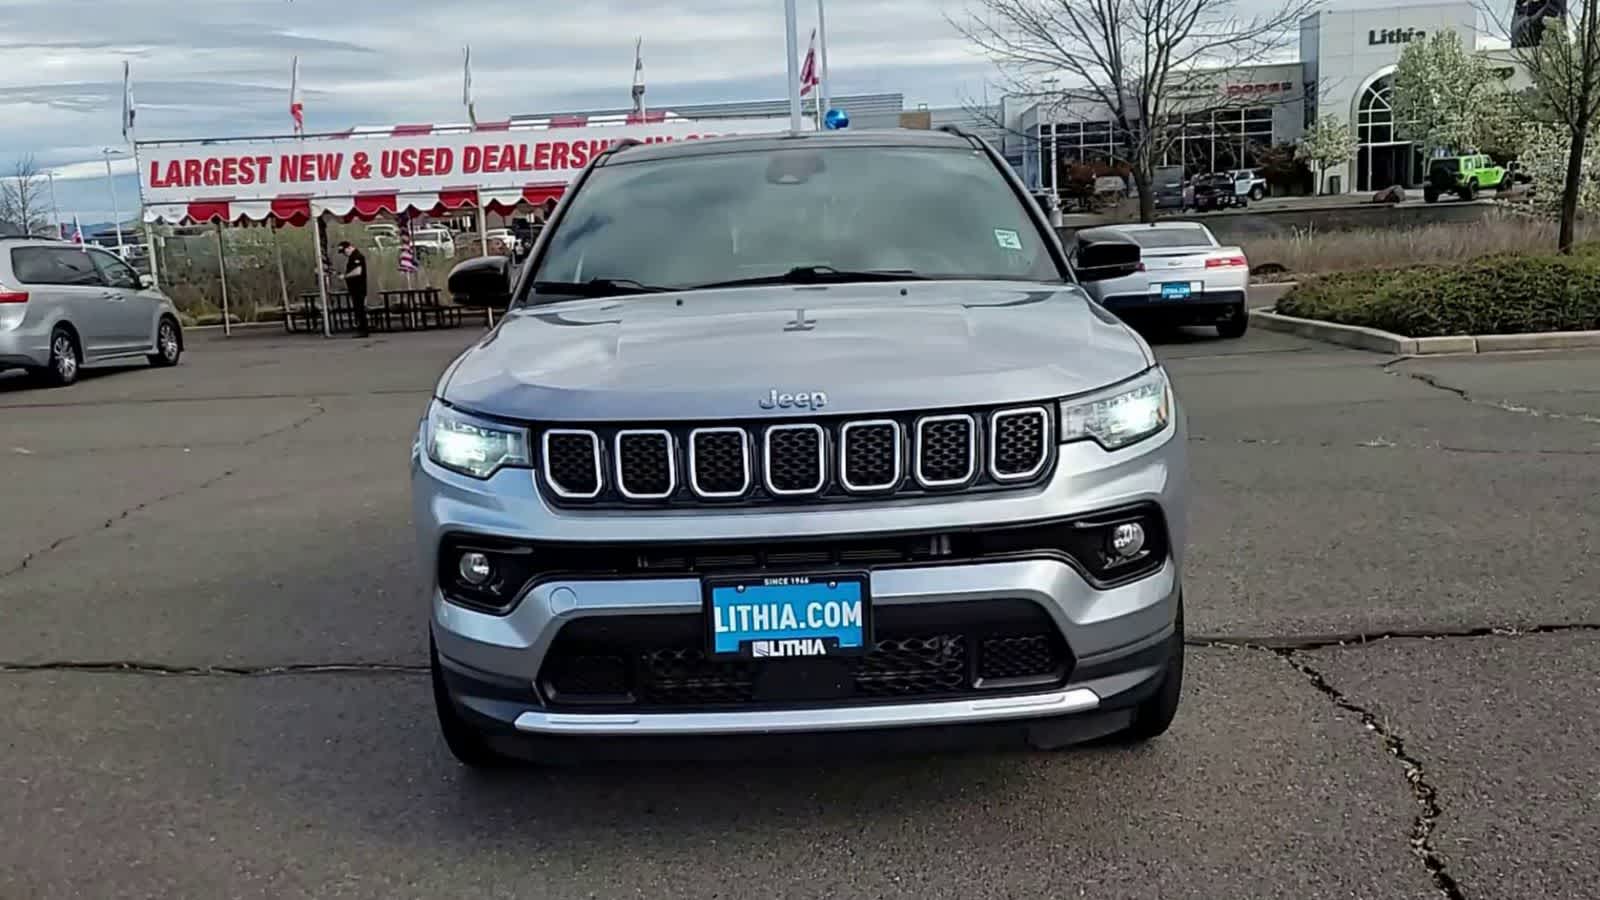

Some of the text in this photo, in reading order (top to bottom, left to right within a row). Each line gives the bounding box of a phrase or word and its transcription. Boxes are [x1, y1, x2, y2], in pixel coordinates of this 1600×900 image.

[150, 139, 616, 188] LARGEST NEW & USED DEALERSH
[759, 389, 827, 411] Jeep
[764, 576, 810, 586] SINCE 1966
[714, 600, 863, 633] LITHIA.COM
[769, 639, 826, 657] LITHIA
